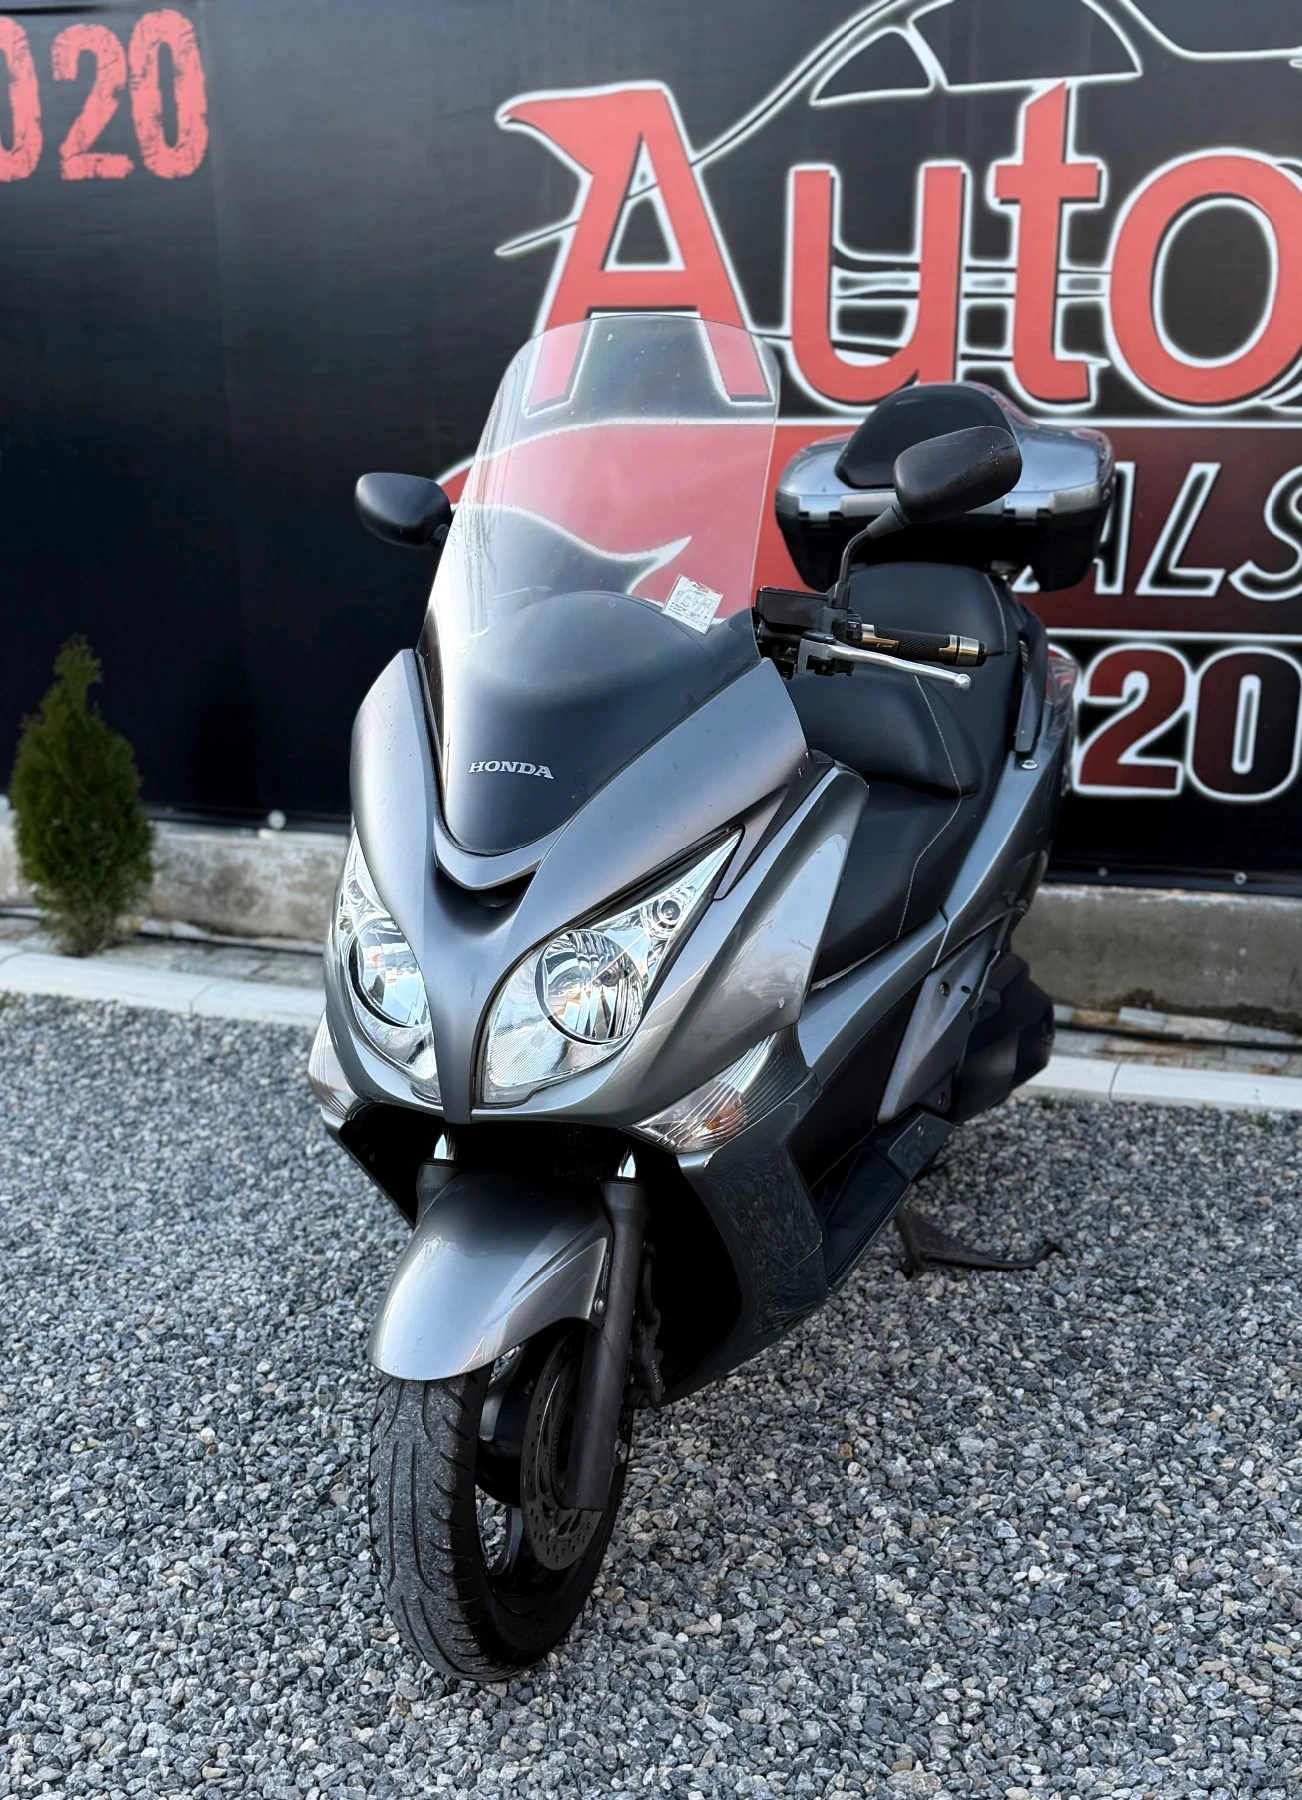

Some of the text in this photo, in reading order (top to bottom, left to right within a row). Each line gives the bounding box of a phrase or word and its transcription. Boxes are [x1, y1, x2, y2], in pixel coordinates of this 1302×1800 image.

[496, 79, 1302, 411] Auto
[468, 760, 554, 779] HONDA
[1048, 643, 1302, 801] 20
